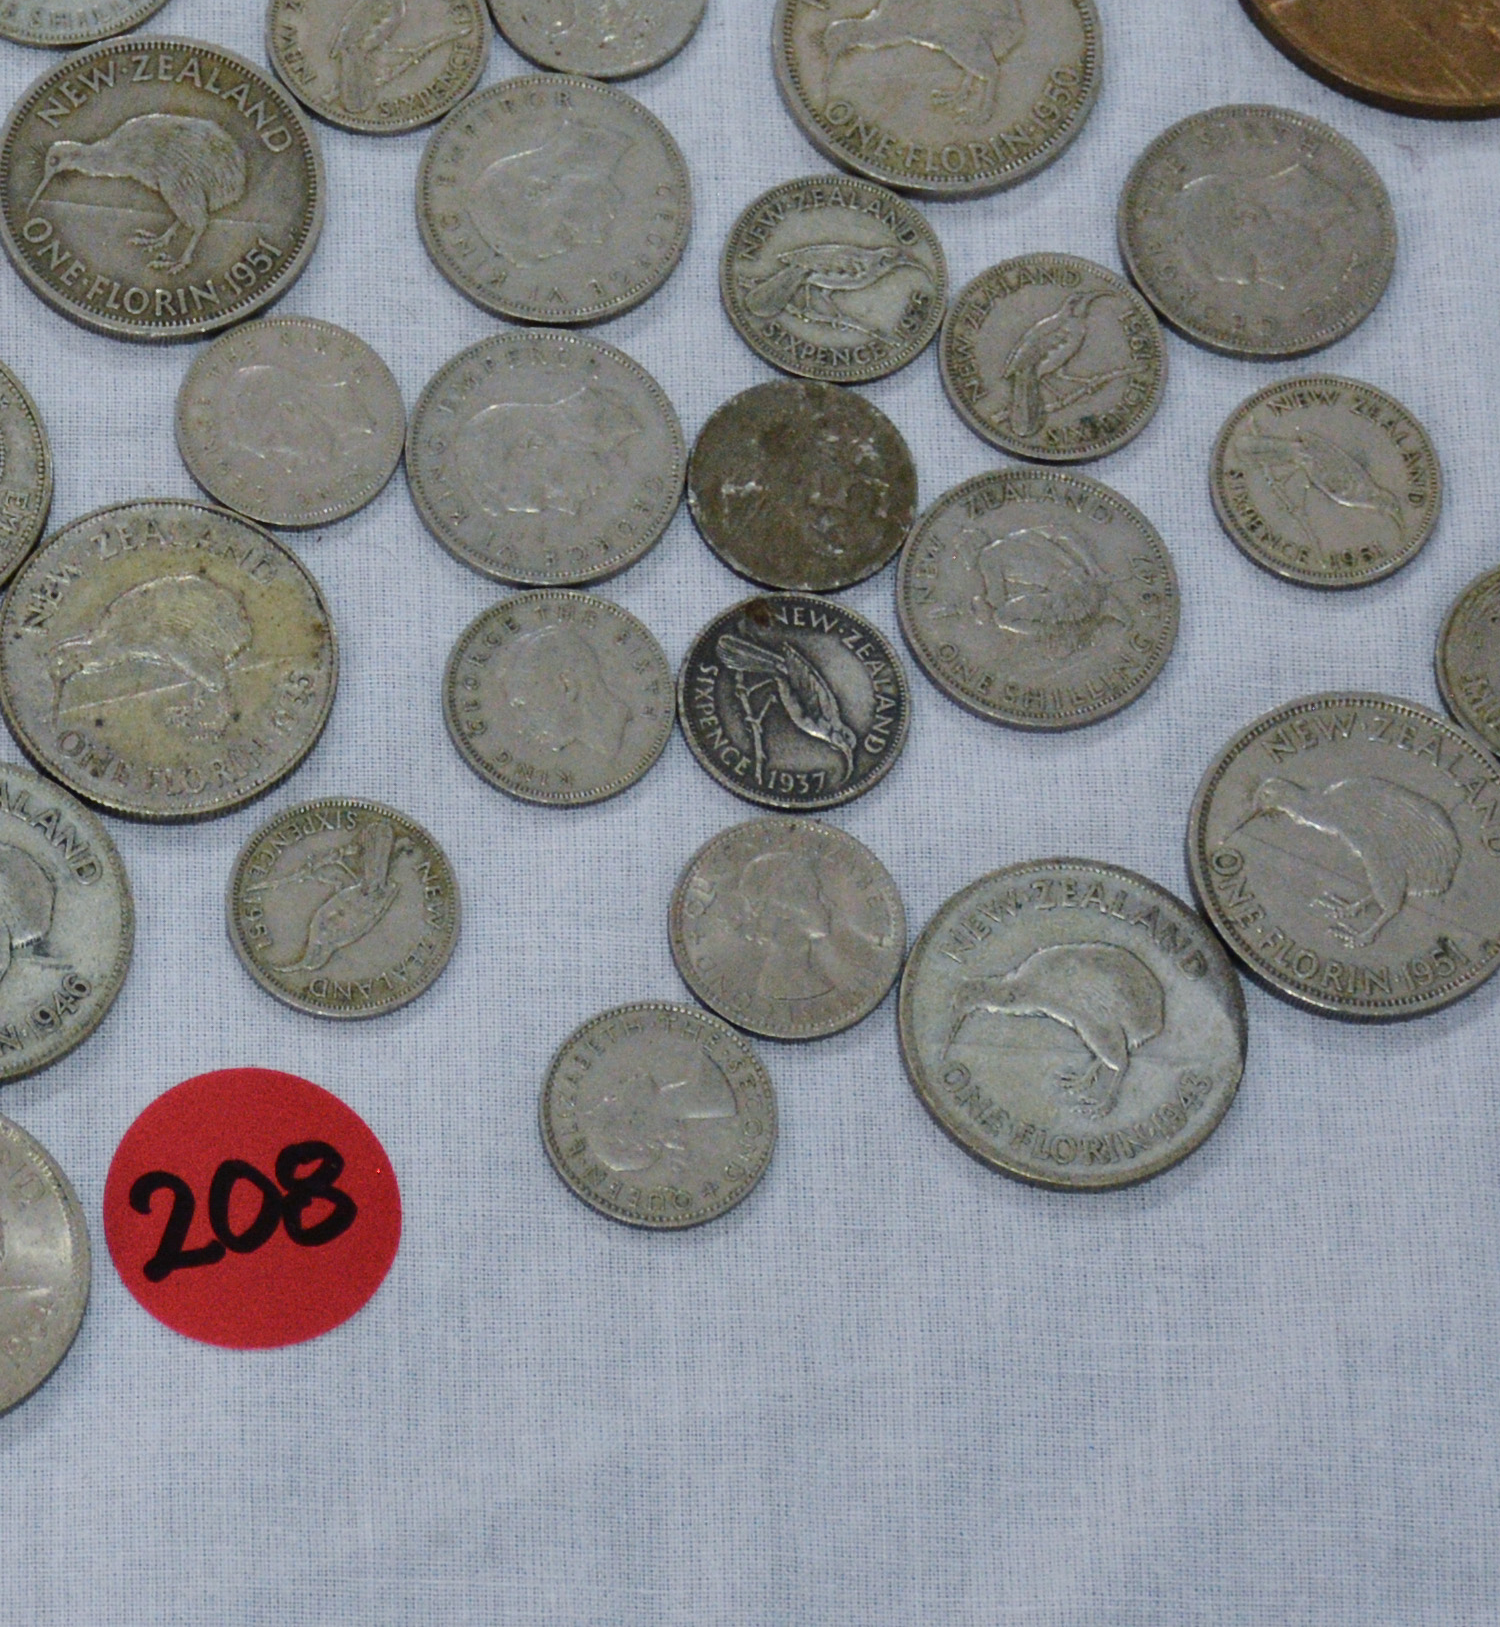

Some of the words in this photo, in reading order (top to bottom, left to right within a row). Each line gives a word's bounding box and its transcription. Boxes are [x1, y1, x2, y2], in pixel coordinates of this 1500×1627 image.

[36, 68, 119, 131] NEW
[128, 53, 294, 155] ZEALAND
[824, 99, 898, 166] ONE
[902, 131, 1026, 173] FLORIN
[1030, 66, 1079, 136] 1950
[21, 216, 86, 291] ONE
[92, 281, 220, 320] FLORIN
[222, 239, 286, 299] 1951
[735, 206, 782, 261] NEW
[793, 188, 920, 247] ZEALAND
[763, 320, 888, 371] SIXPENCE
[965, 268, 1082, 331] ZEALAND
[953, 334, 994, 408] NEW
[1263, 390, 1342, 420] NEW
[1349, 395, 1429, 508] ZEALAND
[696, 661, 754, 778] SIXPENCE
[765, 770, 827, 794] 1937
[774, 604, 836, 636] NEW
[842, 628, 896, 757] ZEALAND
[1266, 711, 1362, 765] NEW
[253, 810, 357, 876] SIXPENCE
[939, 894, 1024, 964] NEW
[1029, 878, 1208, 978] ZEALAND
[1210, 846, 1267, 932] ONE
[1268, 929, 1396, 996] FLORIN
[24, 972, 95, 1038] 1946
[939, 1062, 1003, 1133] ONE
[1007, 1114, 1150, 1166] FLORIN
[129, 1140, 357, 1283] 208
